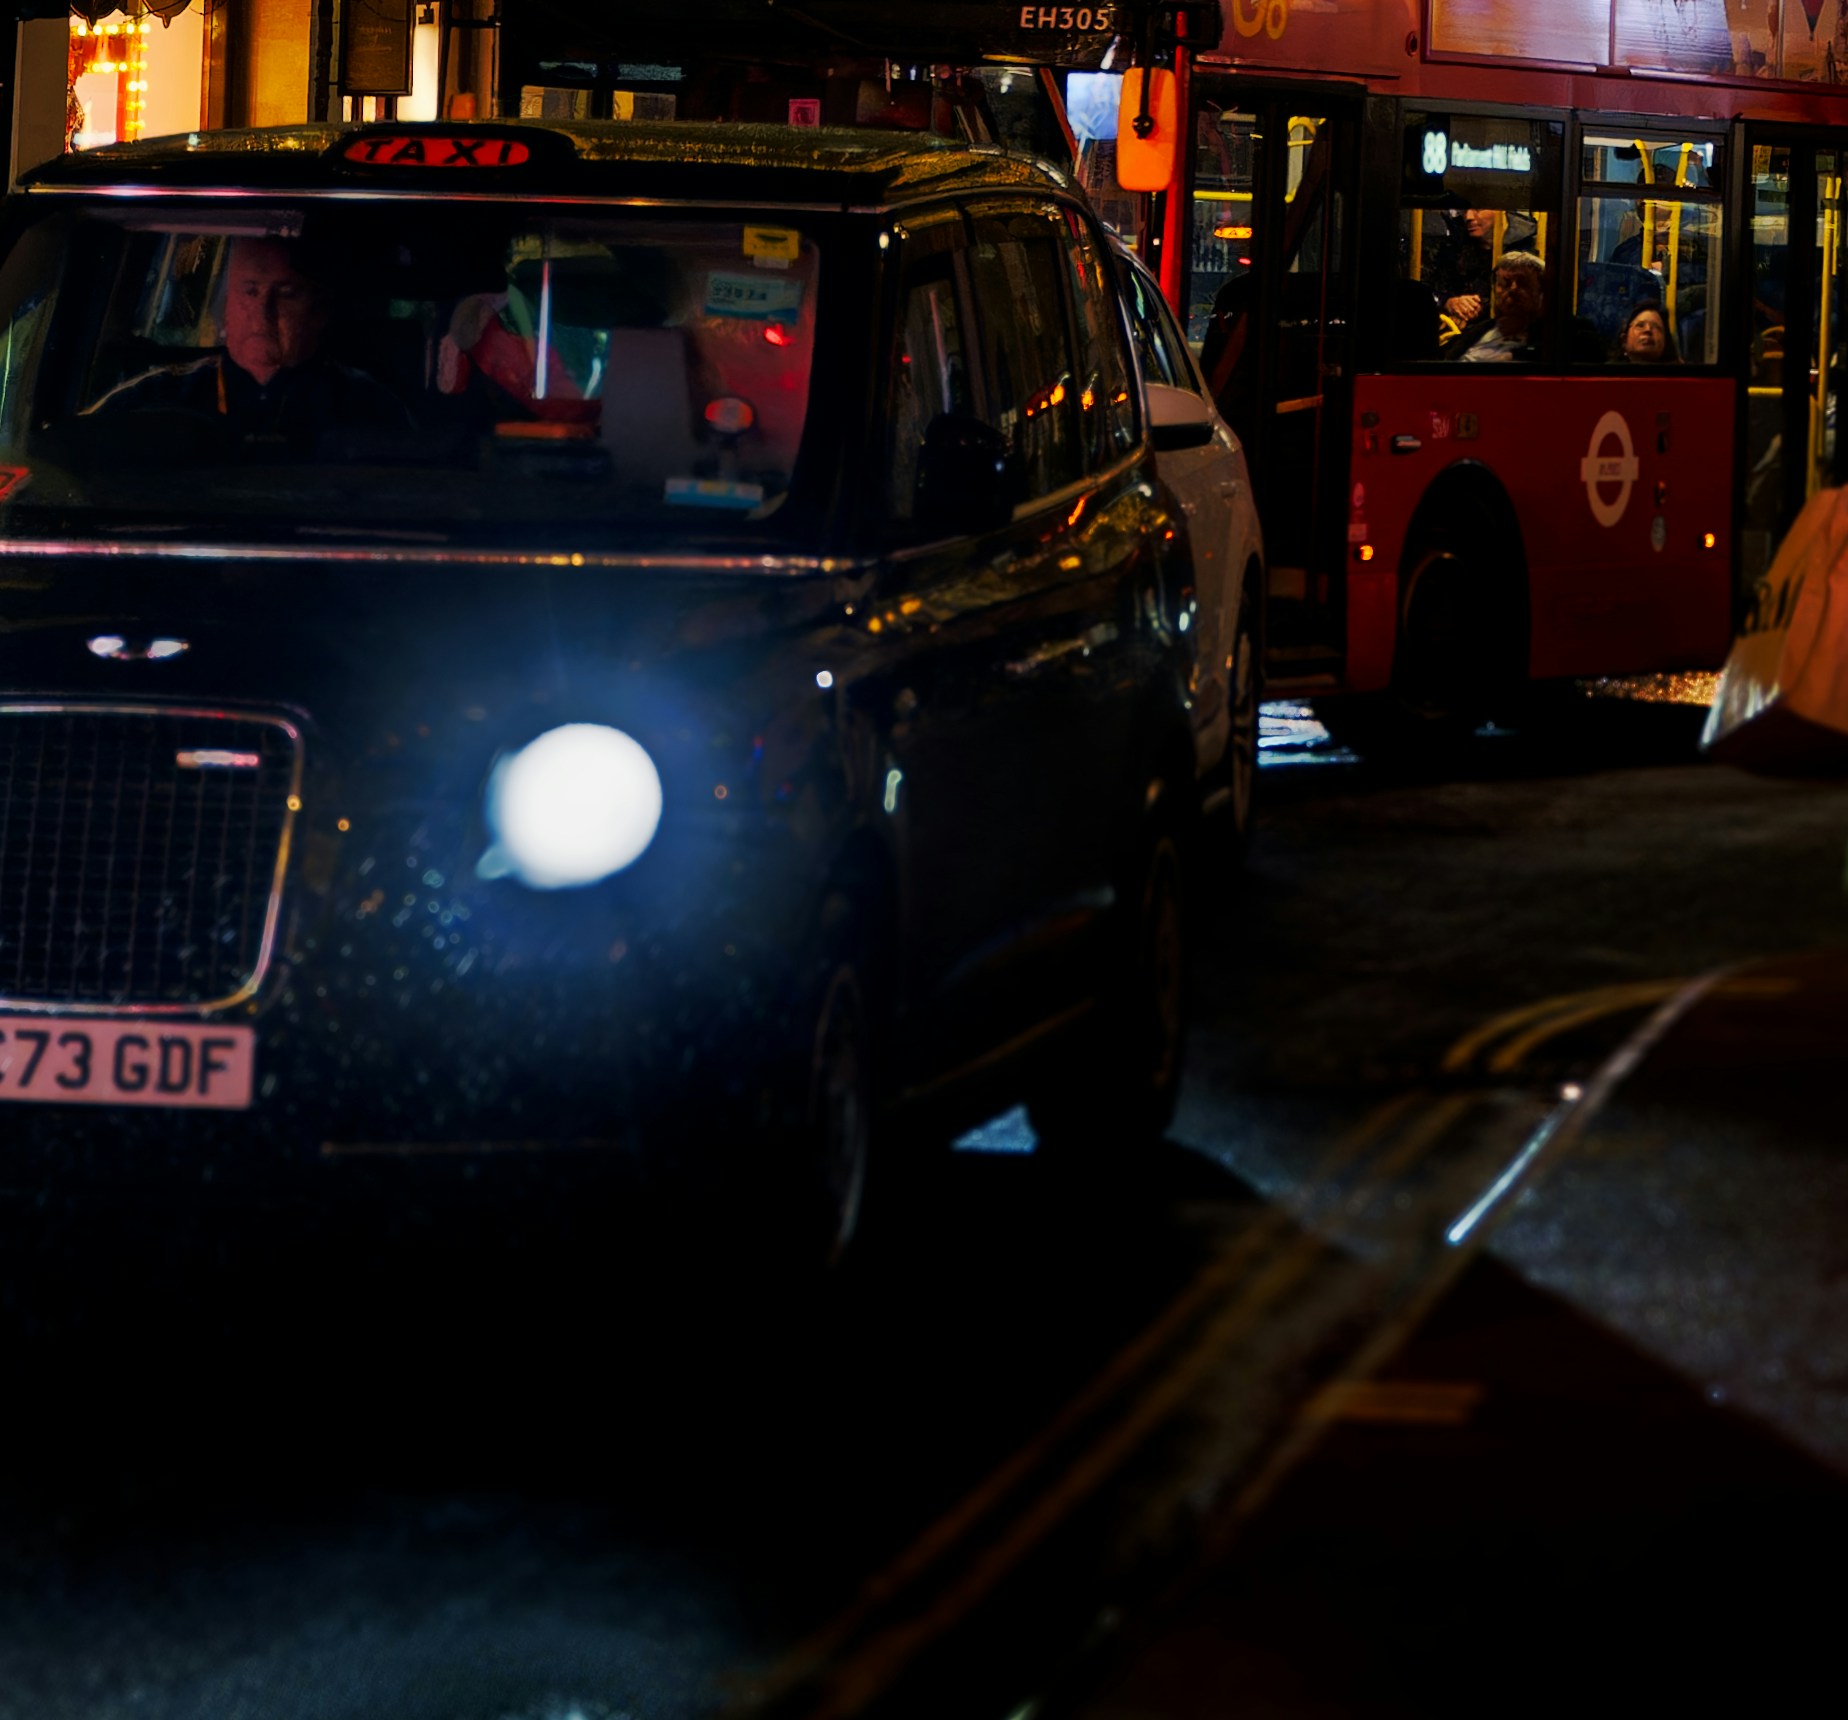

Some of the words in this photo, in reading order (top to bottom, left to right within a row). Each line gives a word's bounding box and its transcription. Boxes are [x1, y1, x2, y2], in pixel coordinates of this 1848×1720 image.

[1019, 5, 1110, 31] EH305
[364, 138, 512, 165] TAXI
[1423, 131, 1447, 174] 88
[0, 1030, 92, 1090] 73
[113, 1034, 238, 1096] GDF
